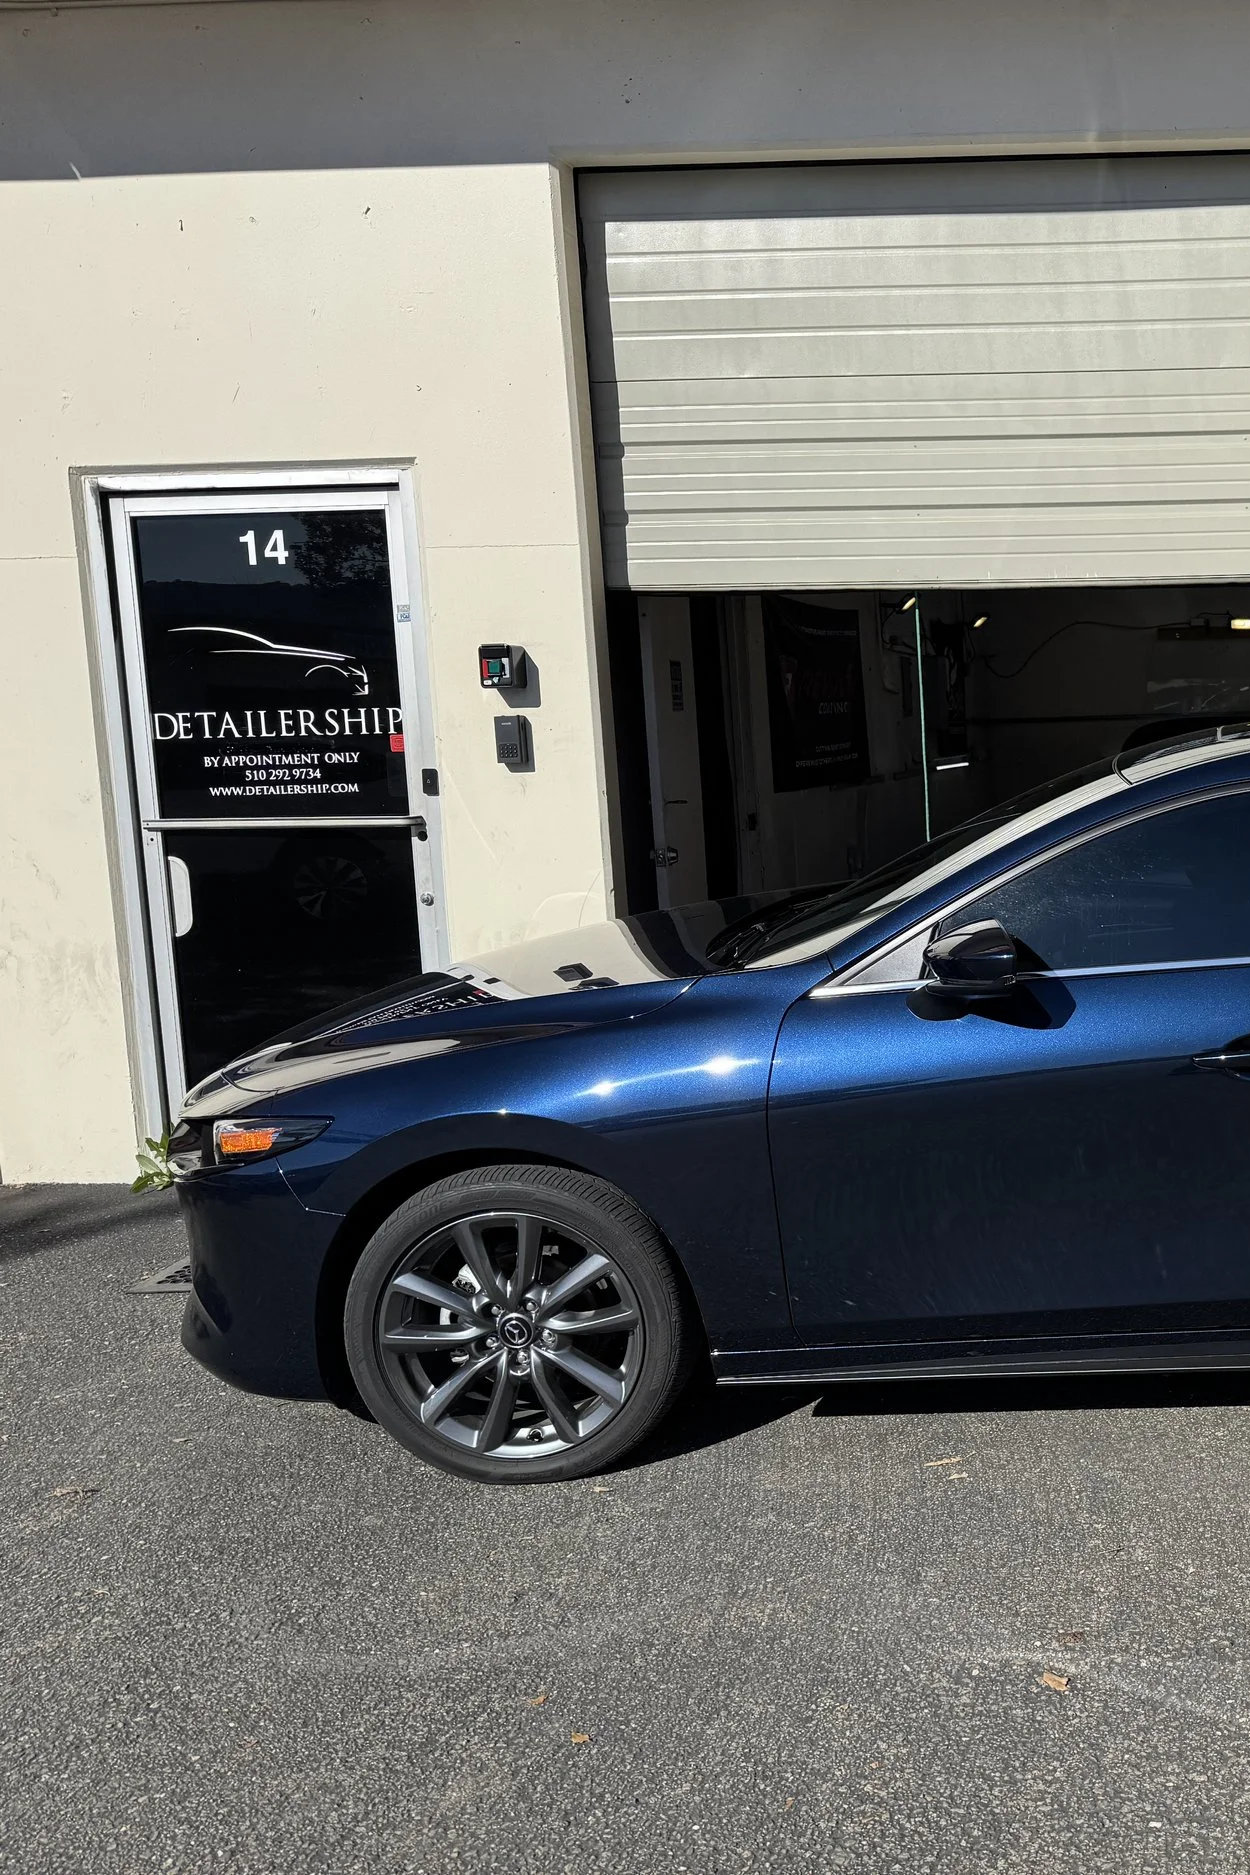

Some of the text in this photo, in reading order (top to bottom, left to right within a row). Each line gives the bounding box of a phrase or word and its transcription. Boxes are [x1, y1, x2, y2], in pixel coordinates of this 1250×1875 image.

[238, 529, 290, 566] 14
[153, 707, 402, 740] DETAILERSHIP
[204, 752, 360, 768] BY APPOINTMENT ONLY
[245, 768, 321, 781] 510 292 9734
[209, 783, 359, 796] WWW.DETAILERSHIP.COM
